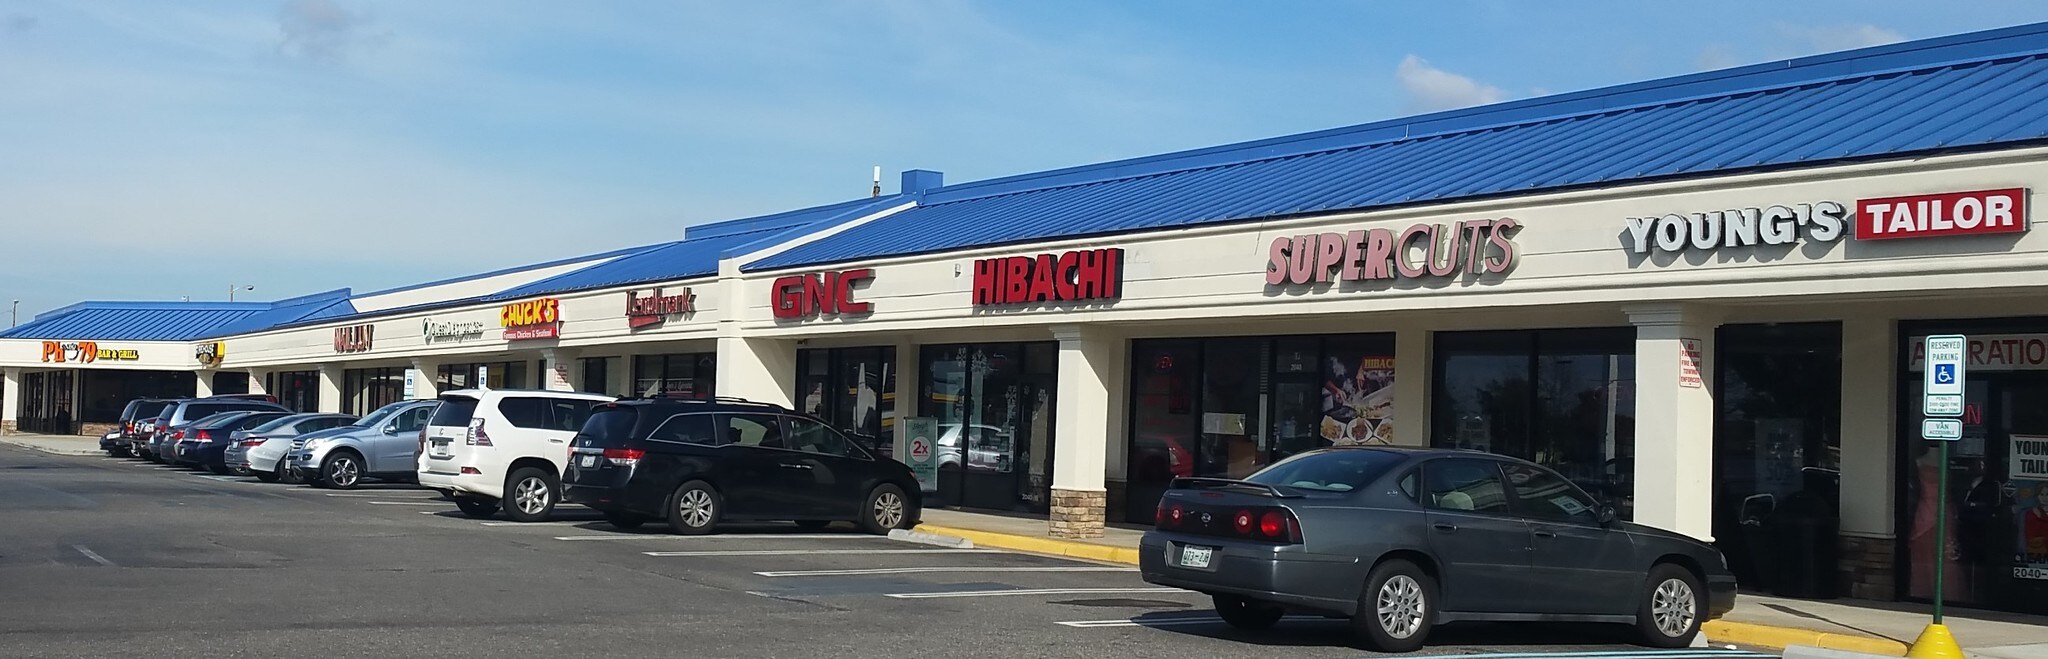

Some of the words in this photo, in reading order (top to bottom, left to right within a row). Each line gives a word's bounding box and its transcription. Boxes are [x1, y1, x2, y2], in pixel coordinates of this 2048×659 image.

[1626, 201, 1846, 253] YOUNG'S
[1866, 195, 2014, 234] TAILOR
[1266, 217, 1518, 285] SUPERCUTS
[972, 248, 1120, 304] HIBACHI
[771, 268, 872, 318] GNC
[500, 298, 556, 327] CHUCK'S
[536, 329, 552, 337] Seafood
[79, 341, 98, 363] 79
[97, 349, 112, 359] BAR
[118, 349, 138, 359] GRILL
[1931, 341, 1961, 349] RESERVED
[1932, 352, 1958, 361] PARKING
[913, 440, 929, 454] 2x
[2020, 459, 2048, 473] TAIL
